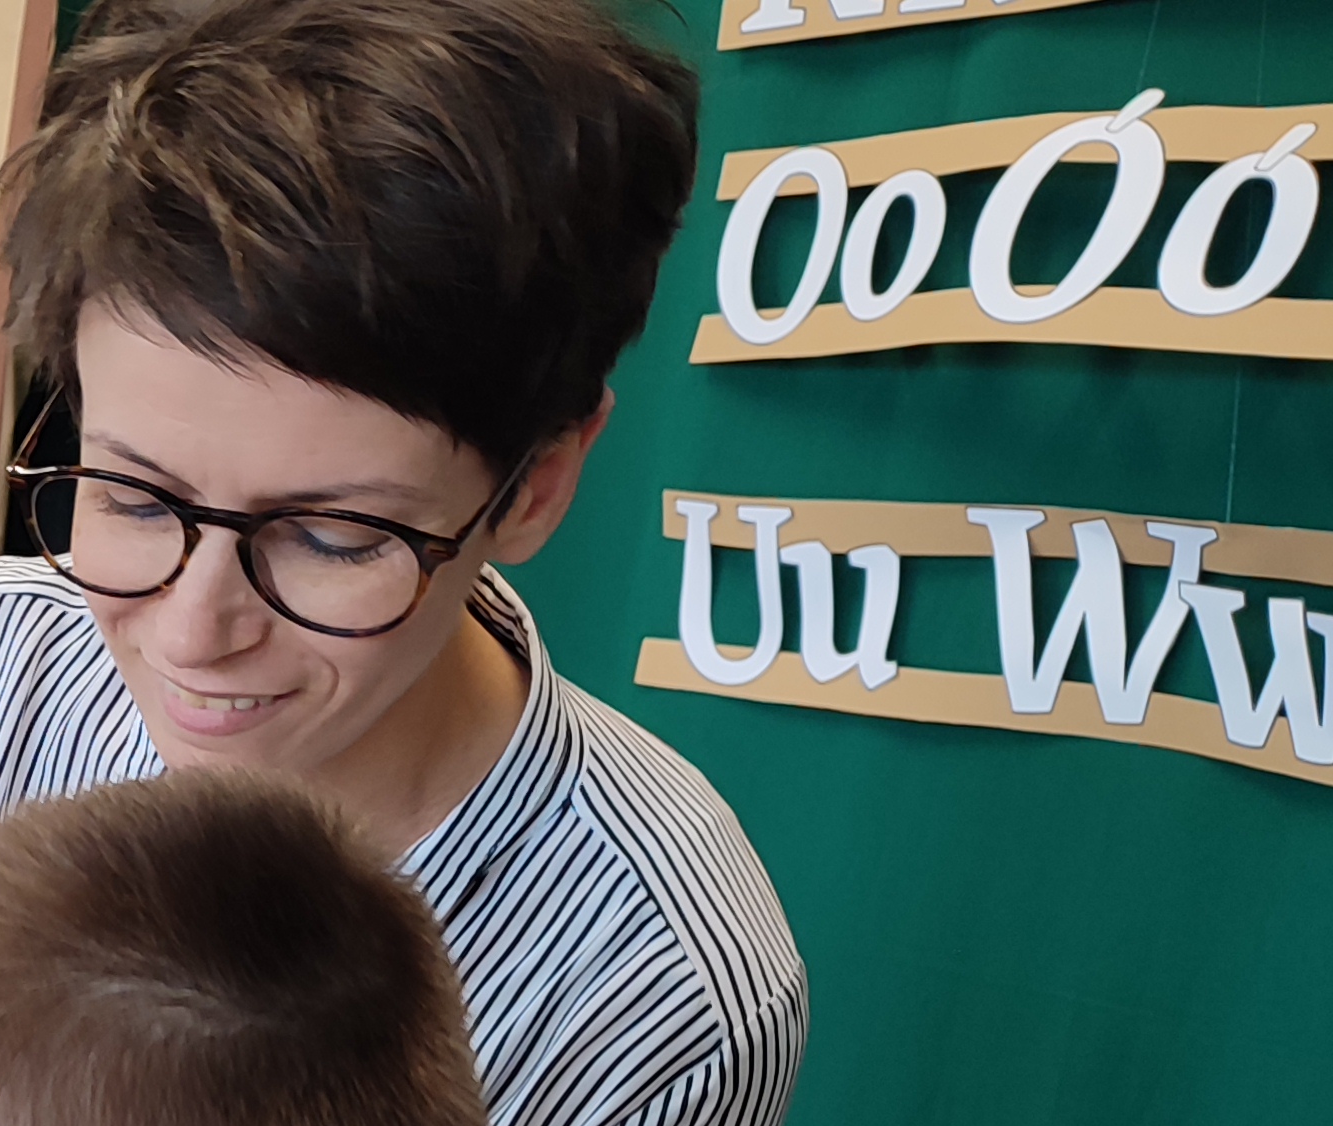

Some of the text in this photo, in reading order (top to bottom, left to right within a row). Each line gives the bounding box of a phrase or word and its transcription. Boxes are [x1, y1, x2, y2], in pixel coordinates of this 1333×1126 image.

[716, 88, 1319, 345] Oo Óó
[676, 499, 1333, 765] Uu Ww
